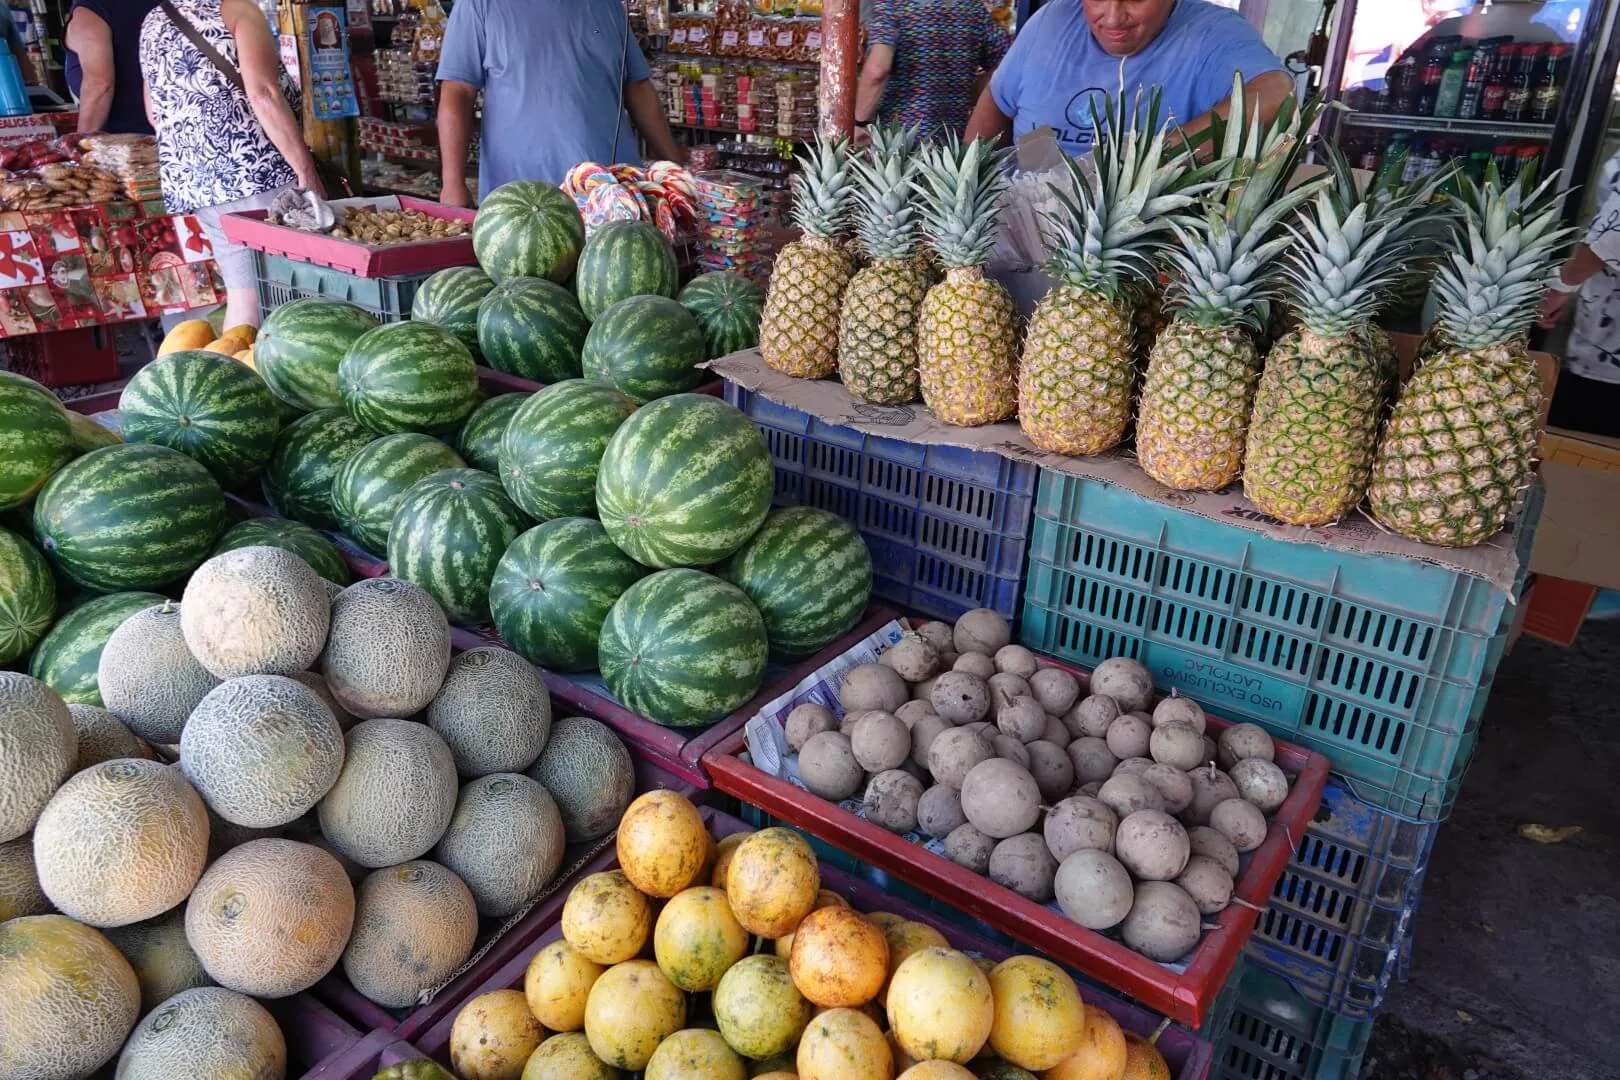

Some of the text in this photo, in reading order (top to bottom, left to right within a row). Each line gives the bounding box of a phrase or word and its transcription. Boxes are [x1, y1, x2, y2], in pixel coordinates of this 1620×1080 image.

[1163, 667, 1282, 712] USO EXCLUSIVO
[1184, 658, 1263, 691] LACTOLAC
